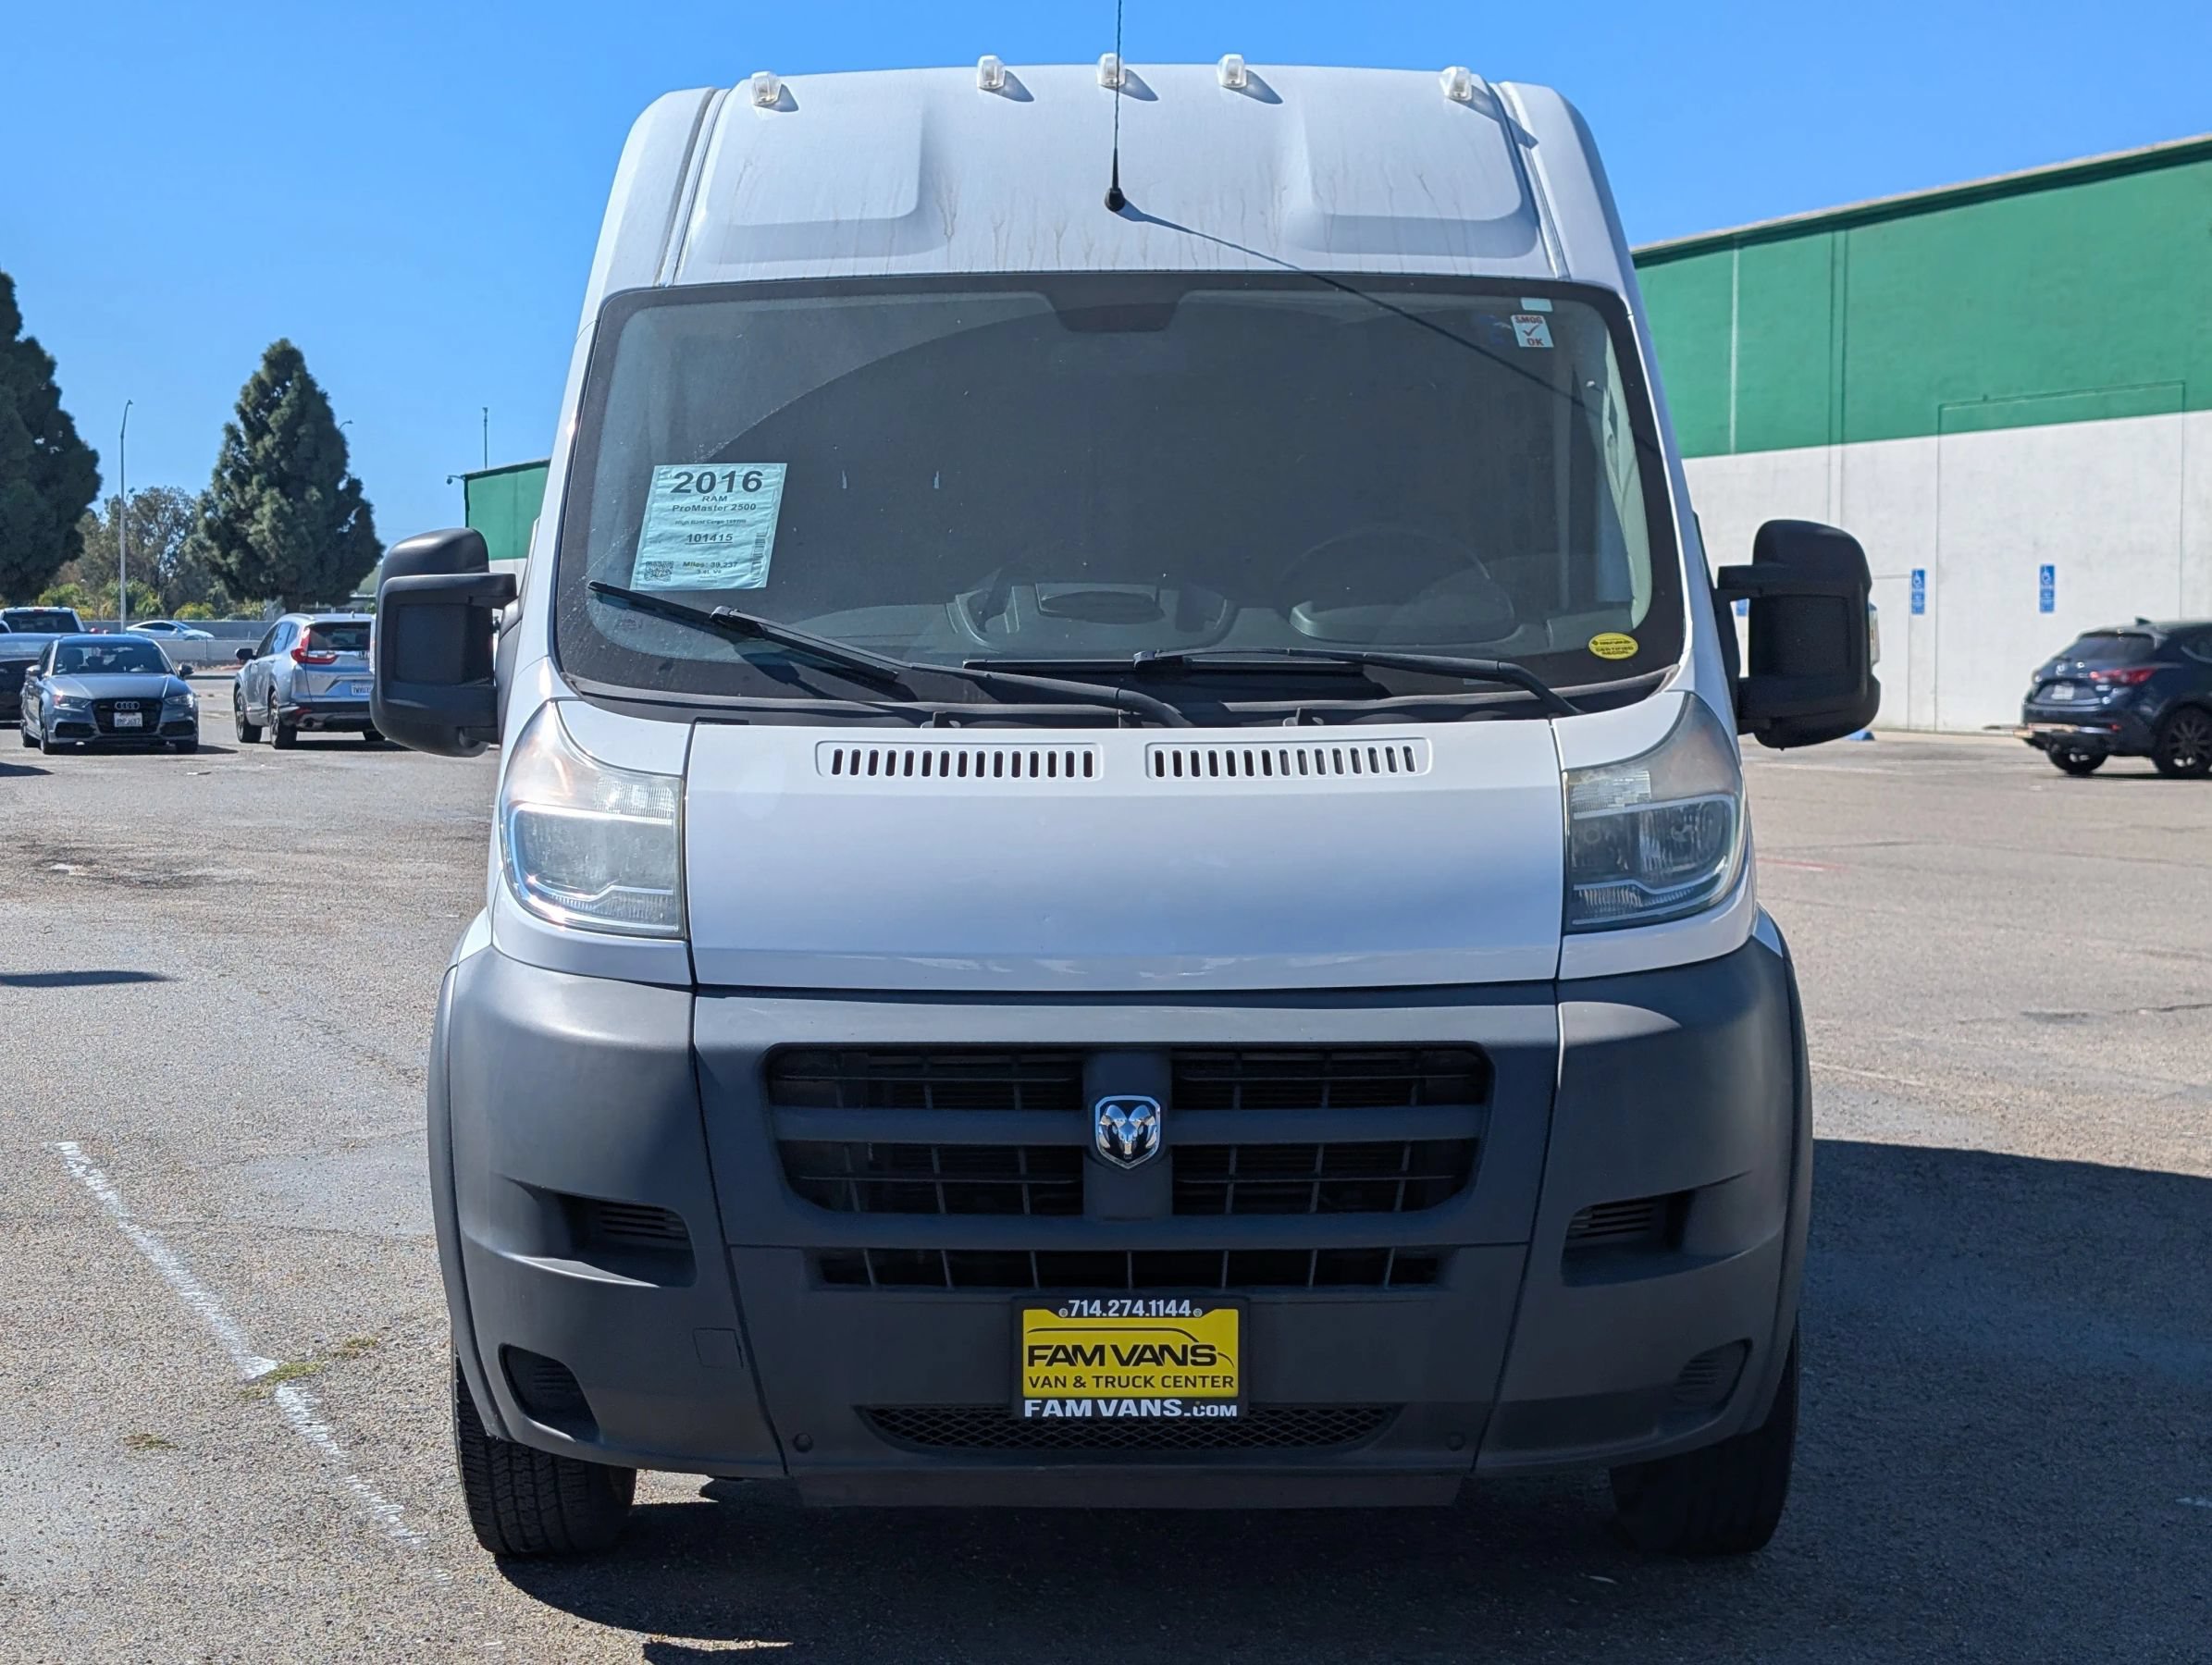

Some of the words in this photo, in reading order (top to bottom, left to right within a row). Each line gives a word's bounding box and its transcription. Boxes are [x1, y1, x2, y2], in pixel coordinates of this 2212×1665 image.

[1526, 338, 1544, 346] OK
[670, 470, 763, 494] 2016
[686, 533, 733, 543] 101415
[1068, 1299, 1191, 1317] 714.274.1144
[1027, 1344, 1106, 1367] FAM
[1109, 1344, 1217, 1367] VANS
[1029, 1375, 1067, 1388] VAN
[1073, 1375, 1087, 1388] &
[1092, 1375, 1155, 1388] TRUCK
[1161, 1375, 1234, 1388] CENTER
